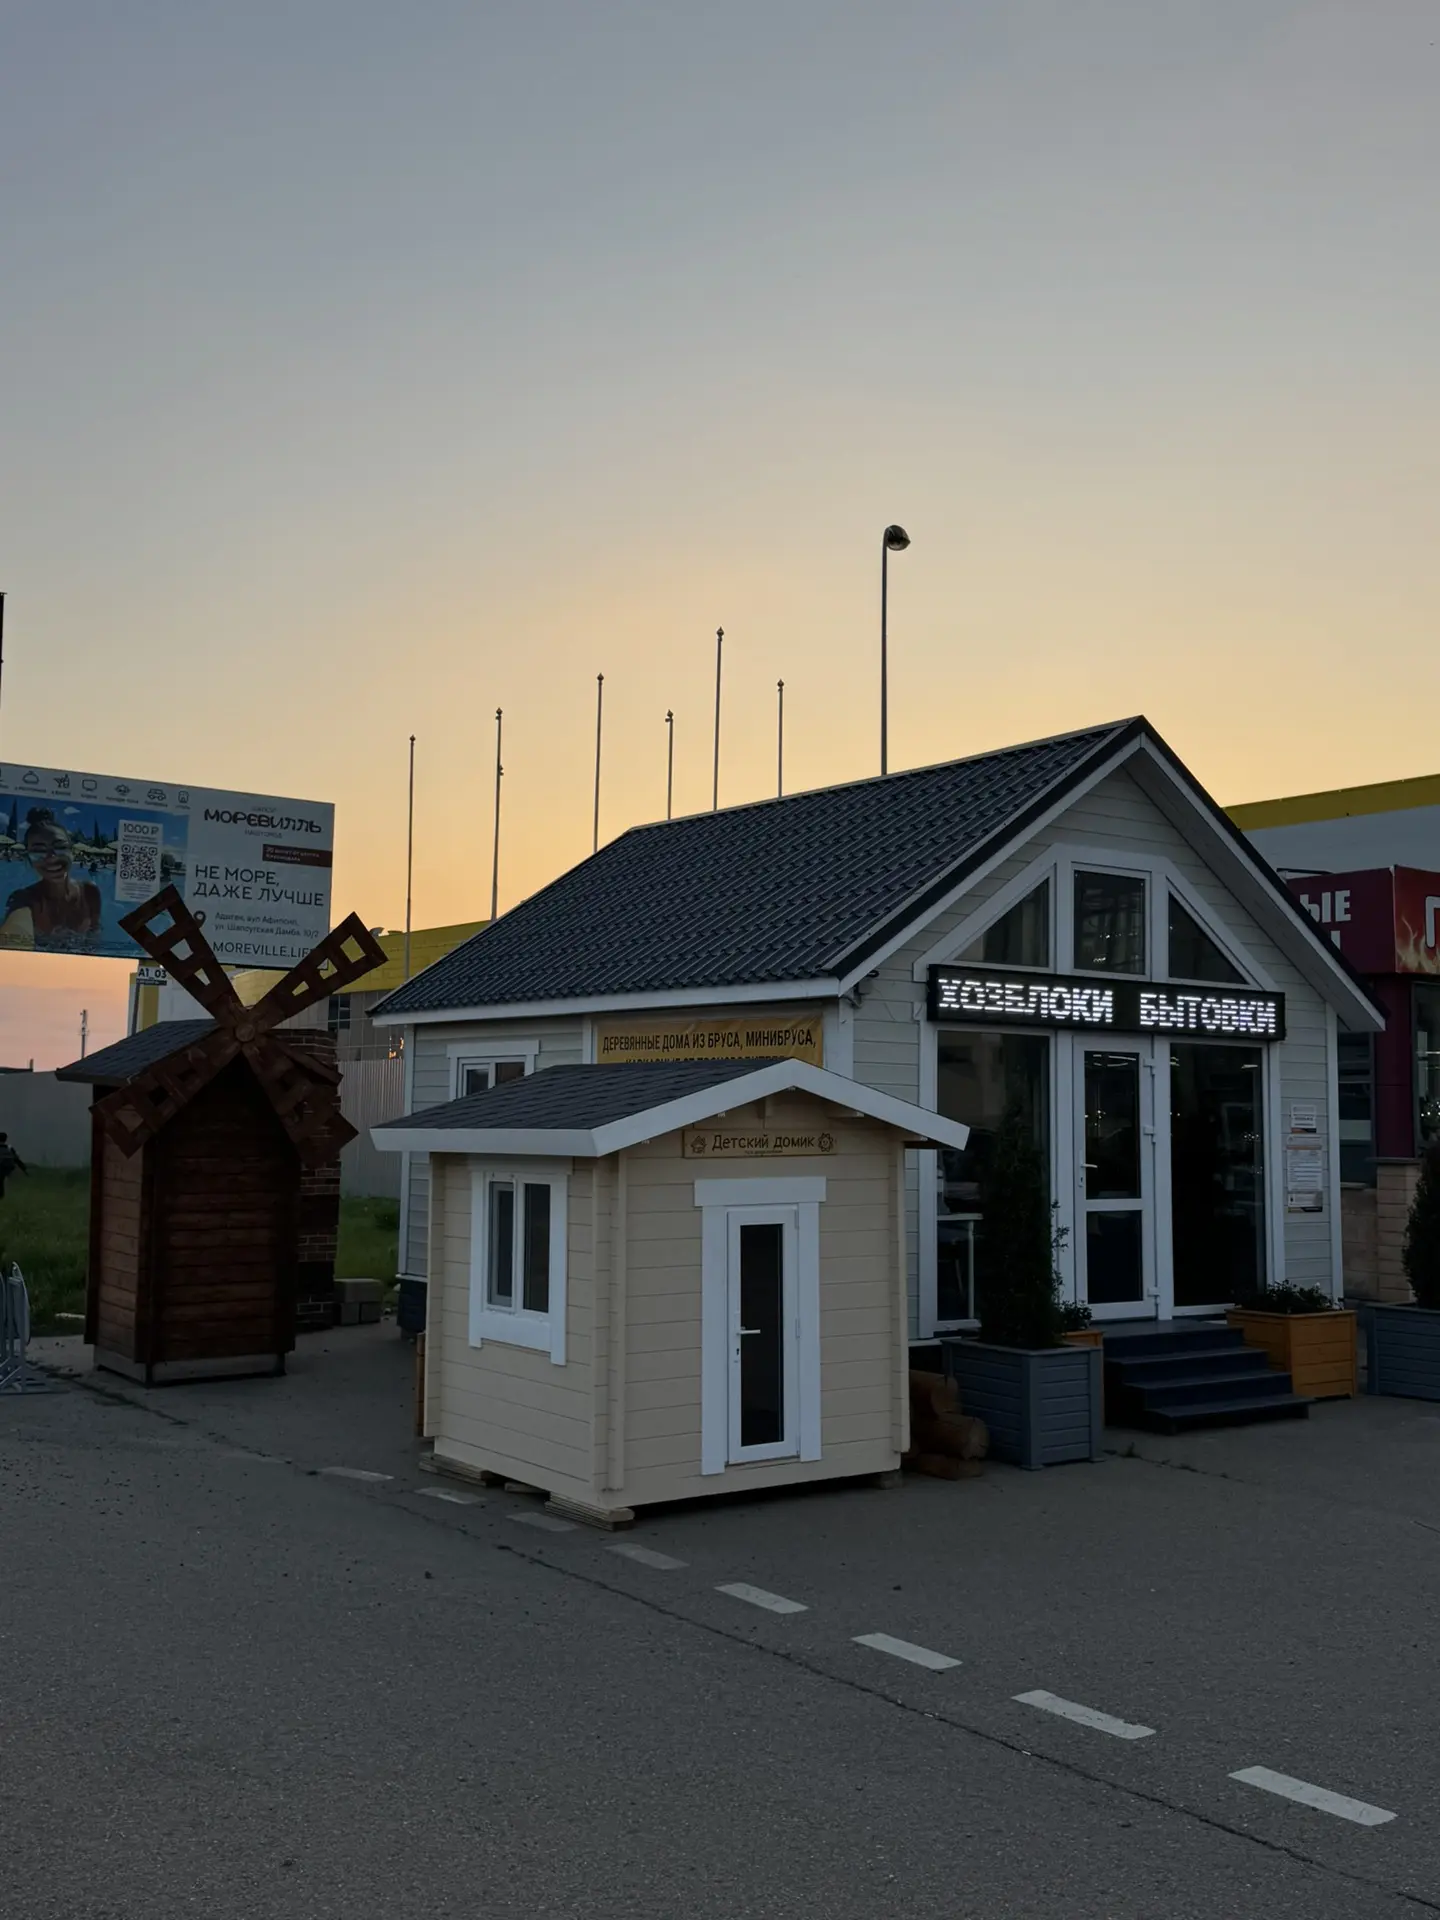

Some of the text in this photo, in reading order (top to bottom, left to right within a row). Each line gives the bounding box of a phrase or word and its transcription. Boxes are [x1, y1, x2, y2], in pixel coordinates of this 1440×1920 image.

[123, 823, 149, 834] 1000
[204, 809, 321, 833] МОРЕВИЛЛЬ
[196, 864, 280, 887] НЕ МОРЕ,
[193, 882, 324, 906] ДАЖЕ ЛУЧШЕ
[213, 941, 313, 958] MOREVILLE.LIF
[938, 978, 1276, 1033] ХОЗБЛОКИ БЫТОВКИ
[603, 1028, 816, 1053] ДЕРЕВЯННЫЕ ДОМА ИЗ БРУСА, МИНИБРУСА,
[712, 1134, 815, 1151] Детский домик
